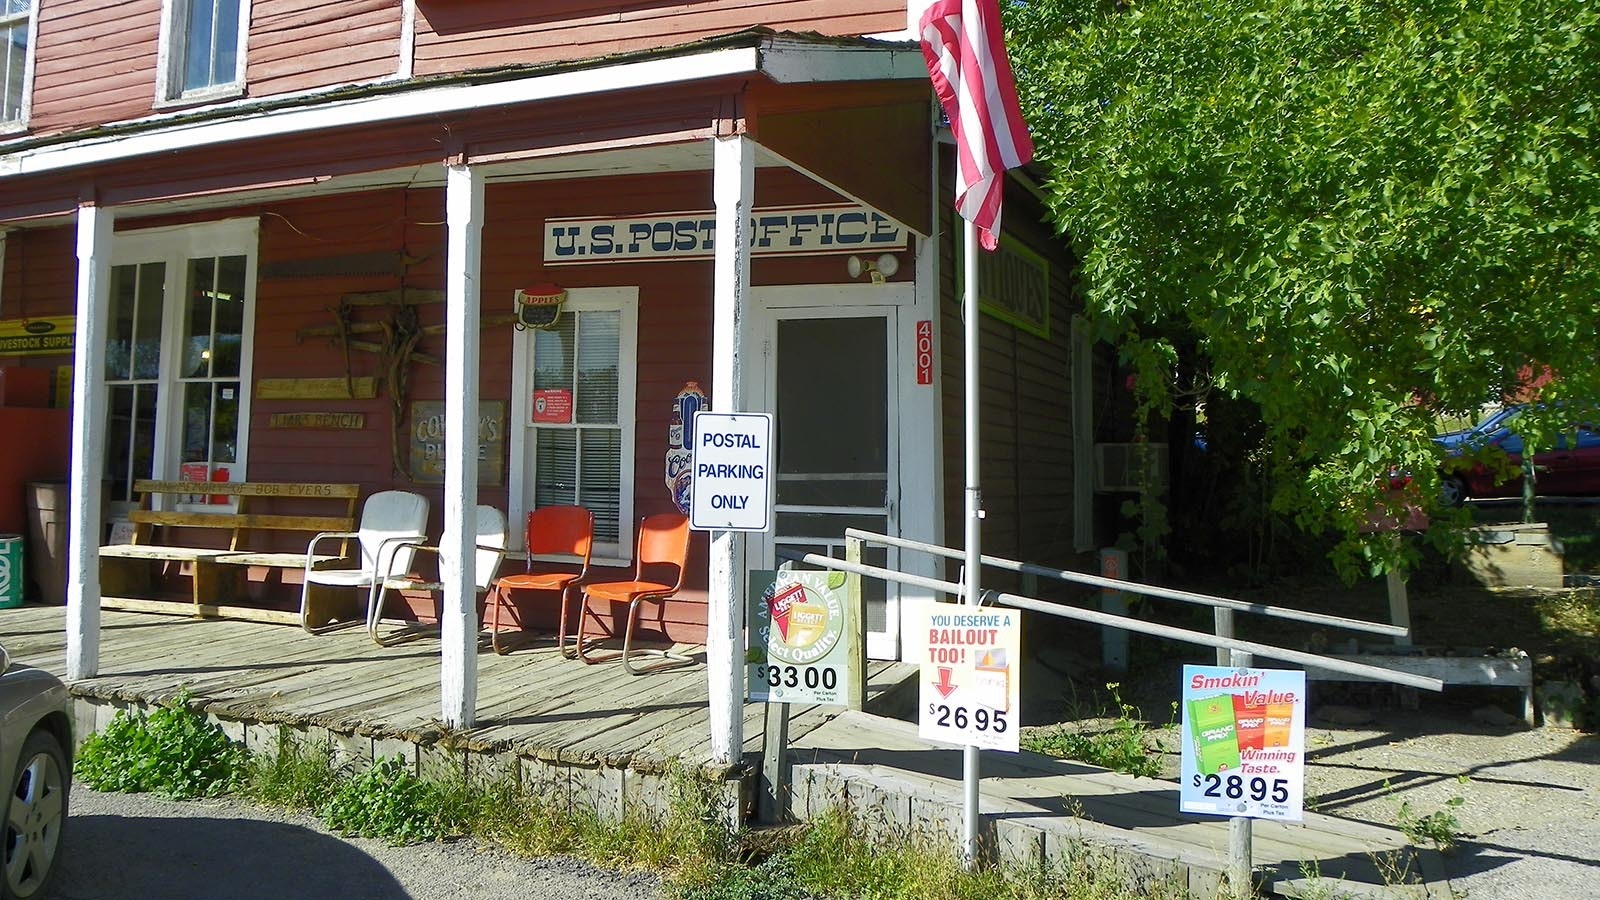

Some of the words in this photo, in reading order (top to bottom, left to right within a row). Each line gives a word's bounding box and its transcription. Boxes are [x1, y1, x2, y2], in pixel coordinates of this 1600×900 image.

[751, 211, 899, 247] FFICE
[527, 296, 560, 304] APPLES
[43, 335, 74, 347] SUPPL
[918, 322, 931, 384] 4001
[316, 414, 359, 428] BENCH
[703, 433, 761, 448] POSTAL
[424, 443, 487, 461] PLE
[698, 464, 764, 479] PARKING
[181, 483, 223, 493] MEMORY
[231, 485, 245, 494] OF
[255, 484, 280, 494] BOB
[288, 485, 332, 496] EVERS
[711, 494, 749, 510] ONLY
[793, 611, 823, 621] LIGGETT
[931, 615, 951, 627] YOU
[953, 615, 1000, 627] DESERVE
[1003, 615, 1011, 627] A
[929, 629, 998, 645] BAILOUT
[929, 647, 965, 664] TOO!
[1191, 672, 1265, 689] Smokin'
[1244, 690, 1299, 705] Value.
[1201, 725, 1234, 738] GRAND
[1241, 749, 1296, 763] Winning
[1240, 763, 1281, 774] Taste.
